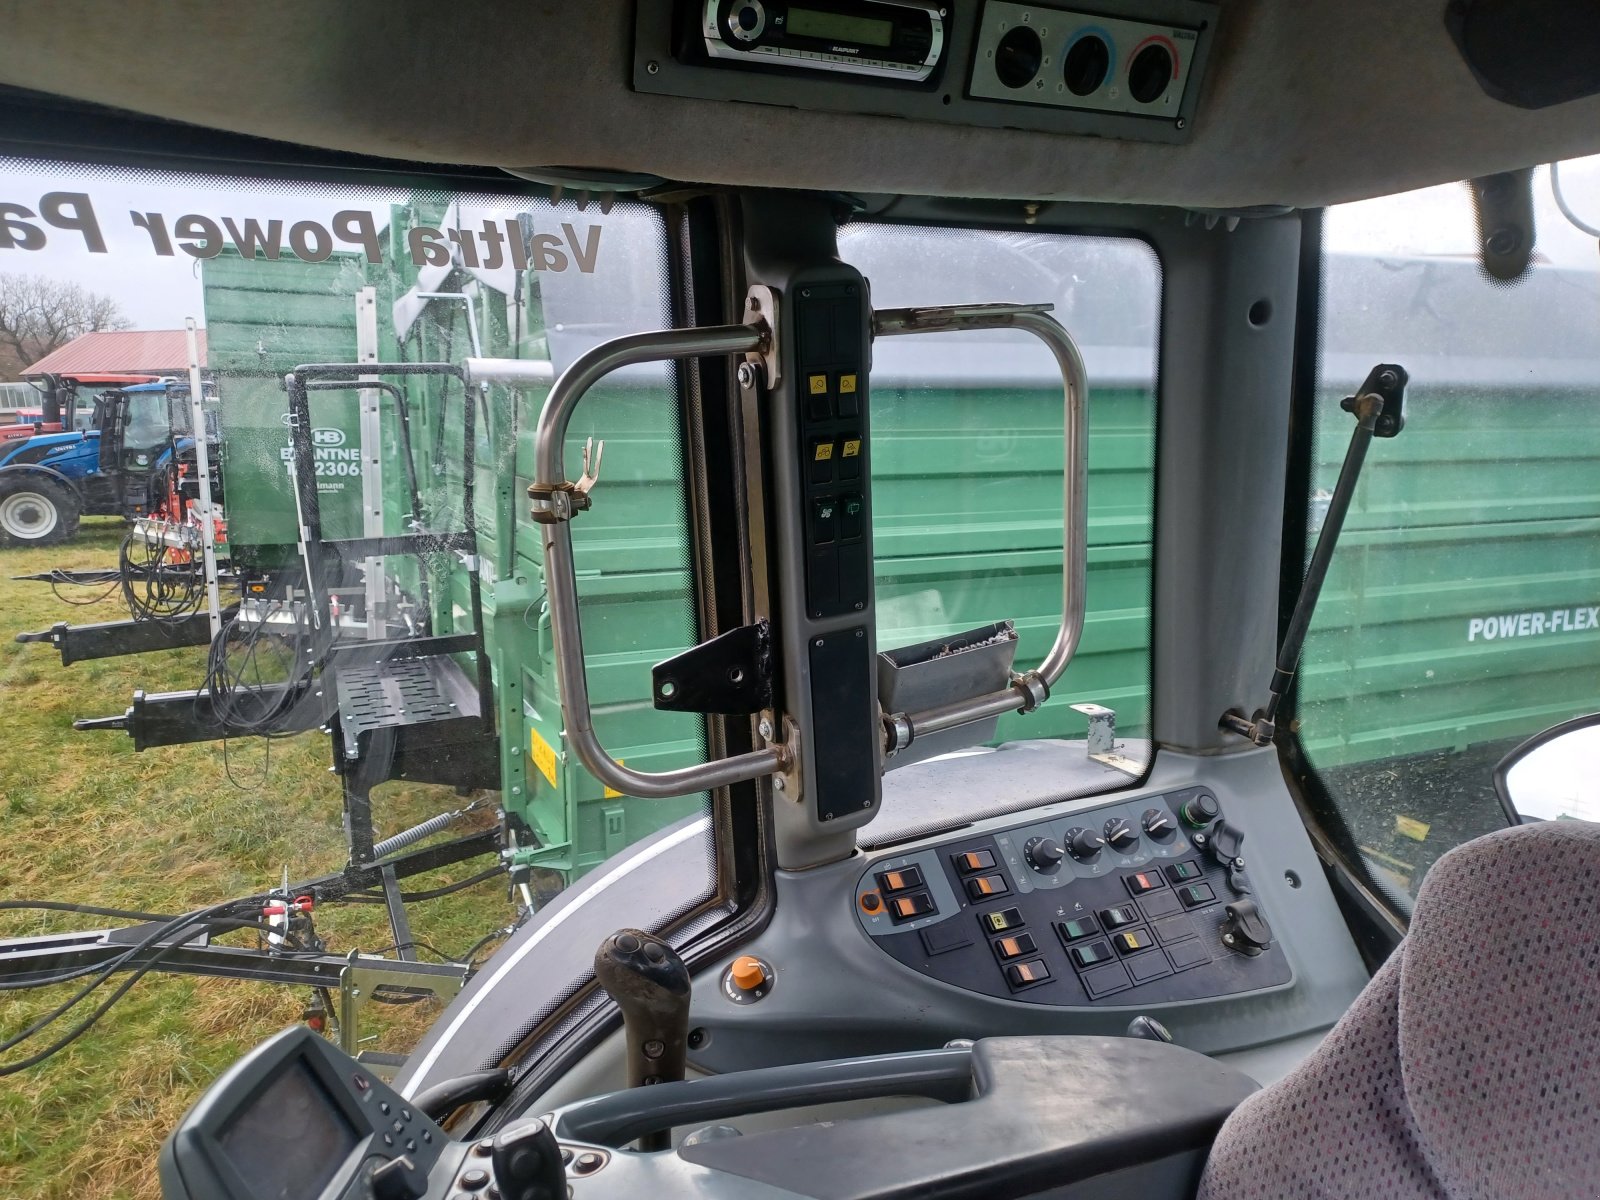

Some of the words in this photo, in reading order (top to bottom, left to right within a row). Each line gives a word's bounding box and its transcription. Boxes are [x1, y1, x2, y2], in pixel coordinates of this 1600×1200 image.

[280, 448, 361, 461] BNTNE
[315, 462, 363, 477] 2306
[1468, 606, 1600, 642] POWER-FLEX
